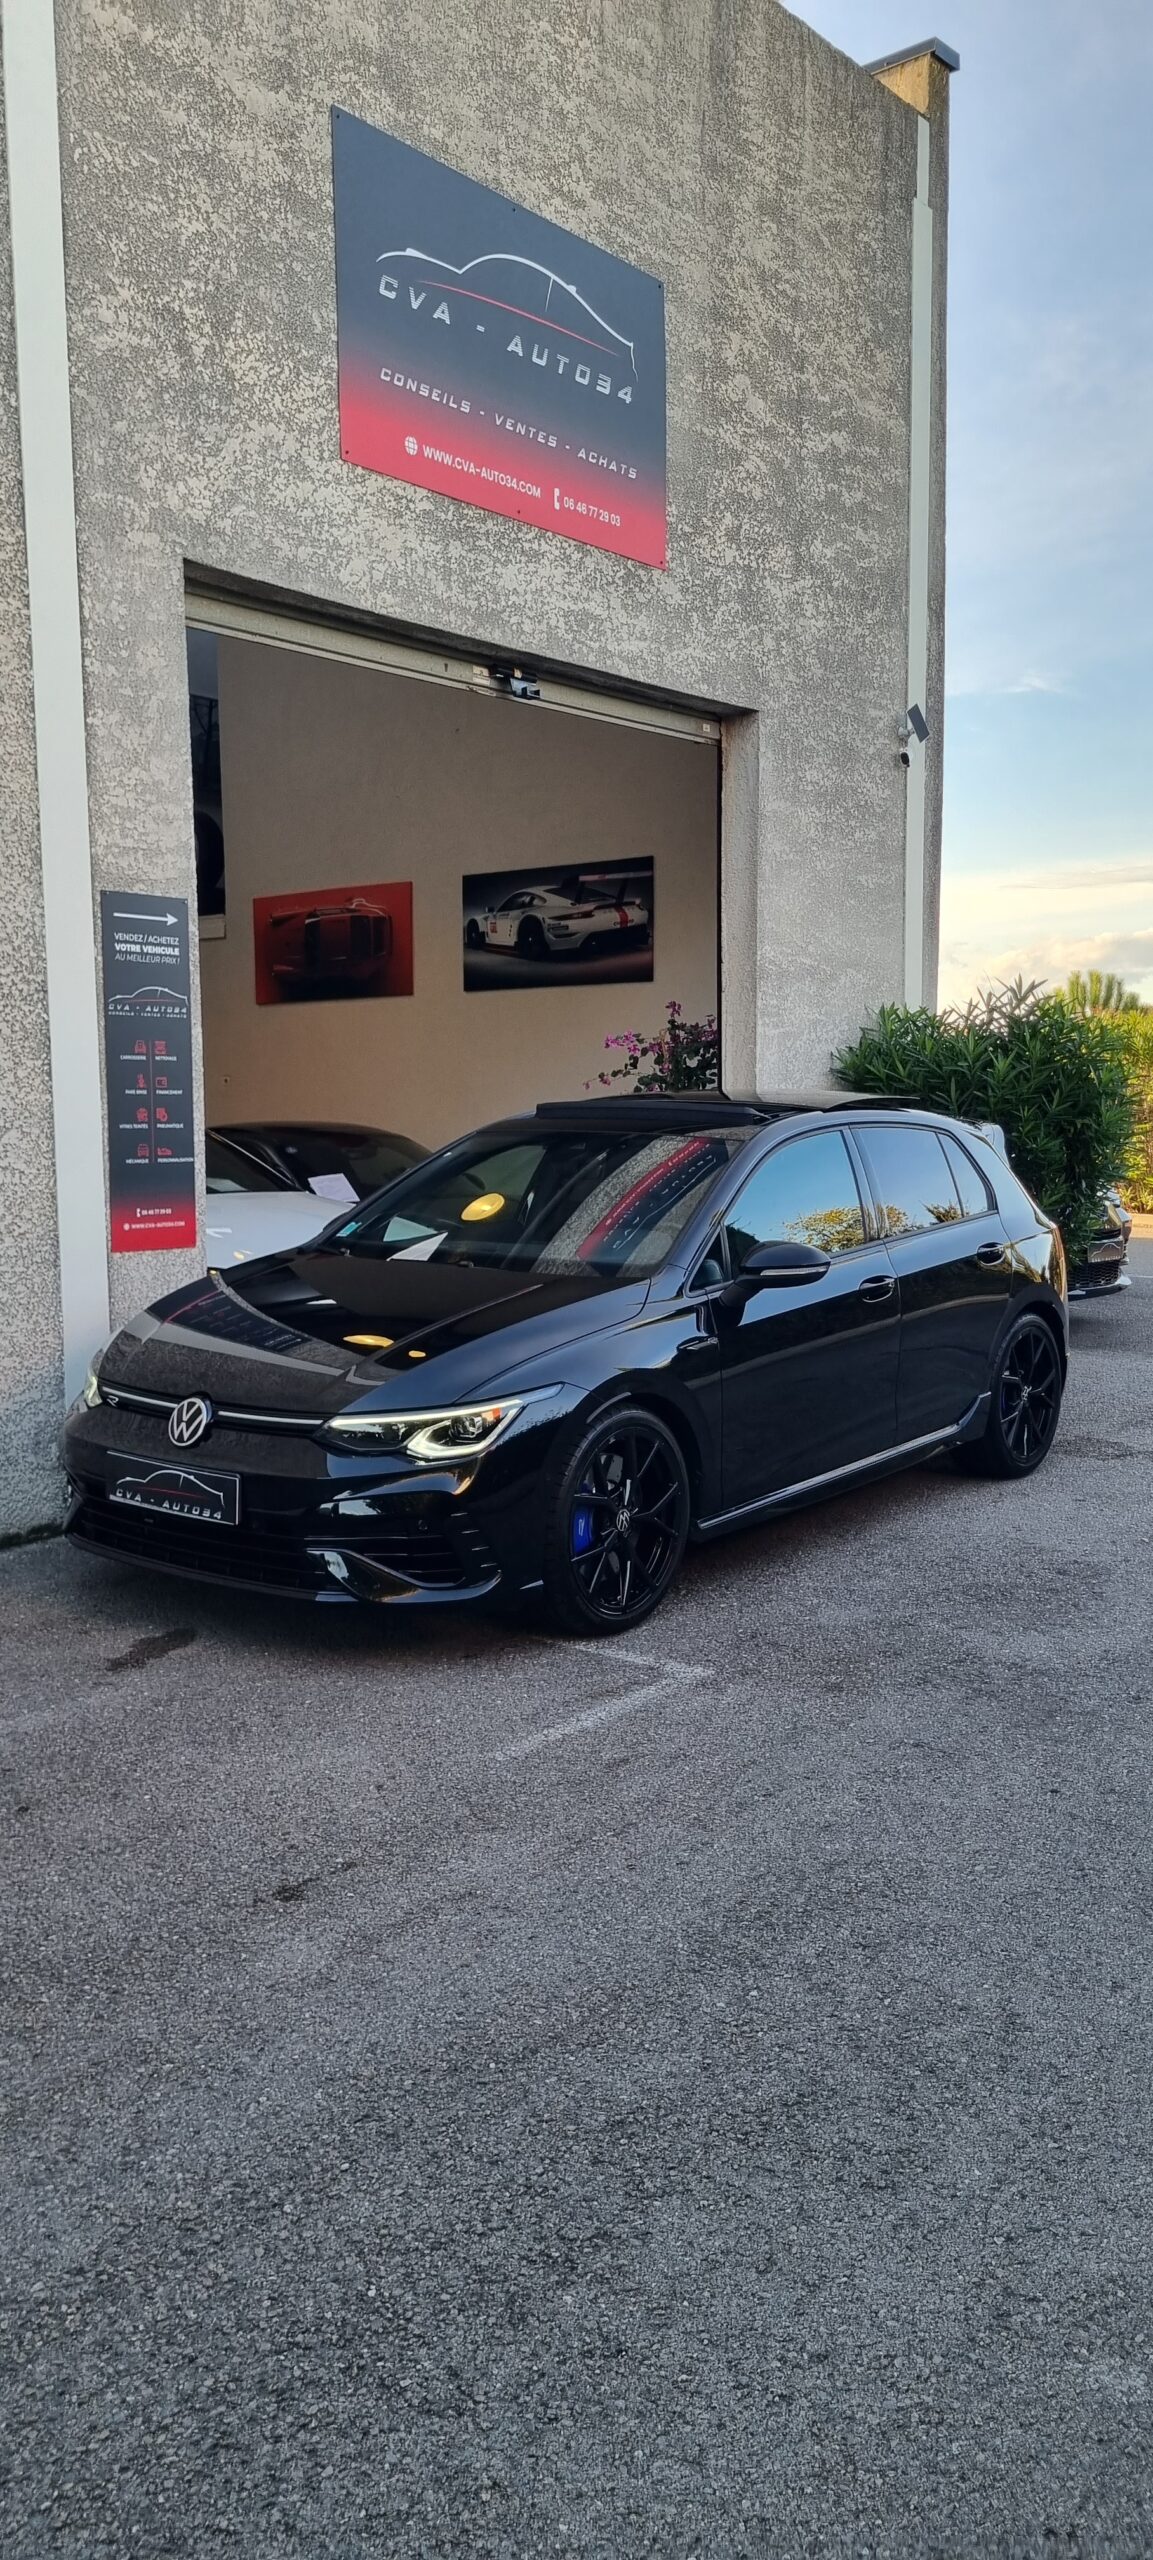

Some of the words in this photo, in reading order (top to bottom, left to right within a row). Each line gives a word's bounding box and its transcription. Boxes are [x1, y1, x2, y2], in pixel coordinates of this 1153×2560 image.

[379, 274, 451, 325] CVA
[507, 335, 633, 404] AUTO34
[380, 368, 471, 414] CONSEILS
[495, 413, 558, 448] VENTES
[577, 448, 638, 479] ACHATS
[423, 444, 541, 498] WWW.CVA-AUTO34.COM
[563, 498, 576, 511] 06
[576, 502, 588, 514] 46
[588, 505, 598, 517] 77
[599, 509, 610, 522] 29
[610, 513, 621, 527] 03
[114, 932, 143, 942] VENDEZ
[148, 935, 179, 945] ACHETEZ
[114, 943, 141, 952] VOTRE
[114, 953, 126, 961] AU
[127, 953, 160, 963] MEILLEUR
[116, 1488, 142, 1502] CVA
[162, 1500, 222, 1519] AUTO34
